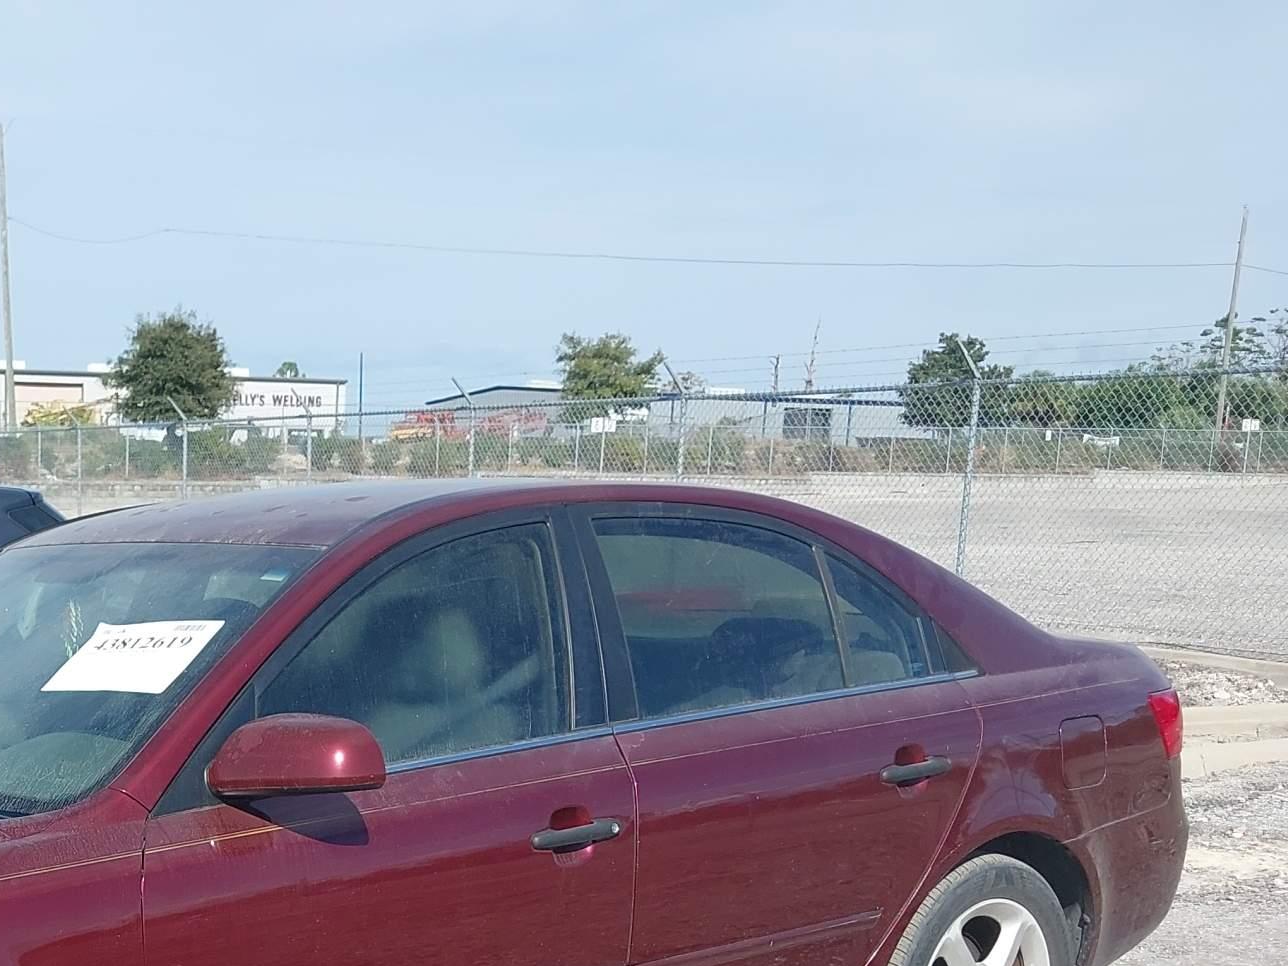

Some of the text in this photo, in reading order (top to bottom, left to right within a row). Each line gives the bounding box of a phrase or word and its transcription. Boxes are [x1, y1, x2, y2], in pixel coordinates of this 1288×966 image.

[230, 394, 322, 408] ELLY'S WELDING
[94, 636, 193, 651] 43812619
